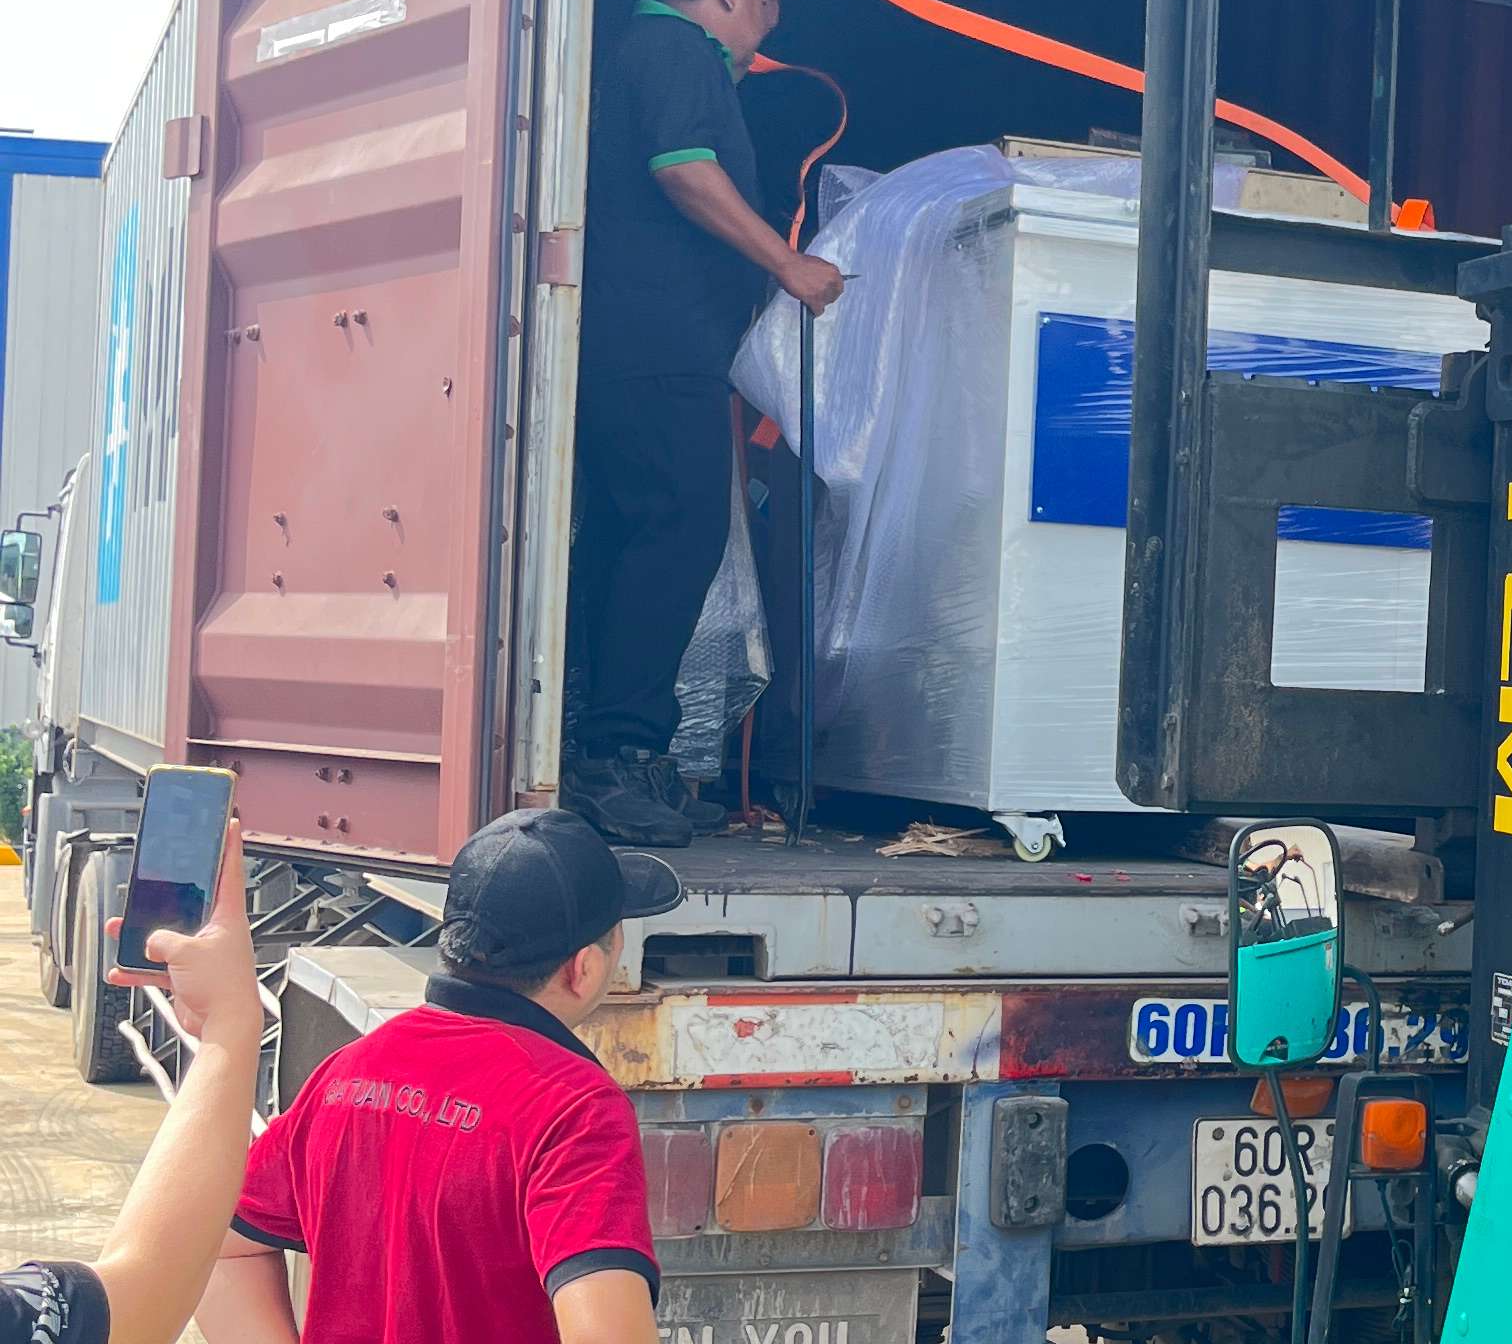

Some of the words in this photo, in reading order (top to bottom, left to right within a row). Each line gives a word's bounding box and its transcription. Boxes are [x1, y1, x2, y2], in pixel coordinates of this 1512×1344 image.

[437, 1095, 481, 1131] LTD
[1234, 1124, 1314, 1177] 60R
[1202, 1182, 1331, 1236] 036.2
